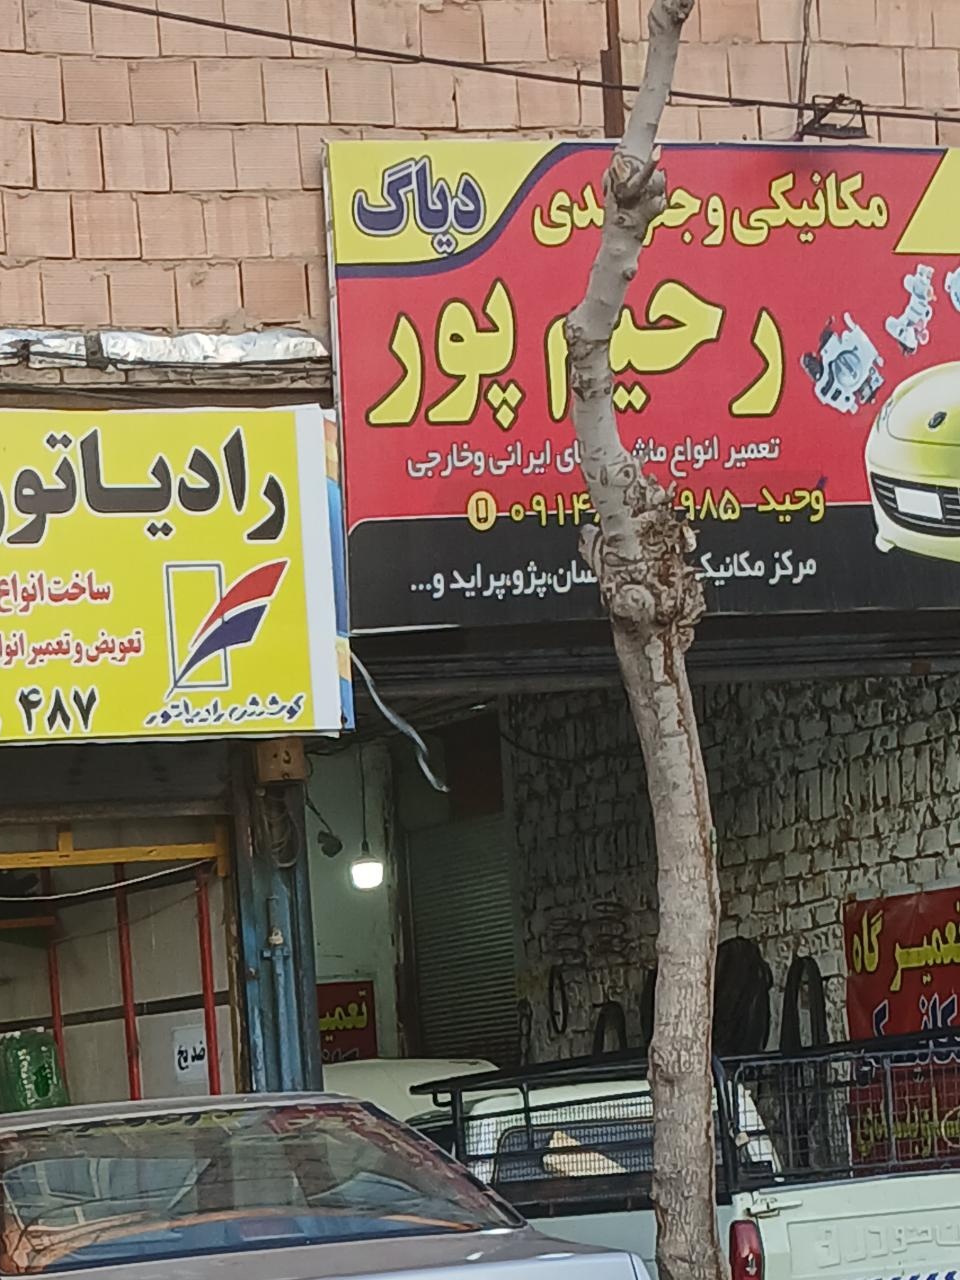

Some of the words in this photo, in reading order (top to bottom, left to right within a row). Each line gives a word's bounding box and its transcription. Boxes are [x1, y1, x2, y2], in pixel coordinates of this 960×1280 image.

[352, 155, 486, 255] دیاگ
[702, 194, 726, 246] و
[731, 171, 889, 246] مکانیکی
[365, 277, 525, 430] پور
[489, 440, 551, 476] ایرانی
[670, 436, 719, 477] انواع
[724, 437, 781, 469] تعمیر
[757, 486, 826, 523] وحید
[695, 551, 766, 586] مکانیک
[768, 550, 817, 584] مرکز
[48, 571, 110, 603] ساخت
[27, 632, 70, 665] تعمیر
[73, 642, 82, 664] و
[86, 630, 142, 662] تعویض
[18, 687, 97, 732] ۴۸۷
[890, 900, 960, 992] عمیر
[319, 989, 368, 1042] تعمی
